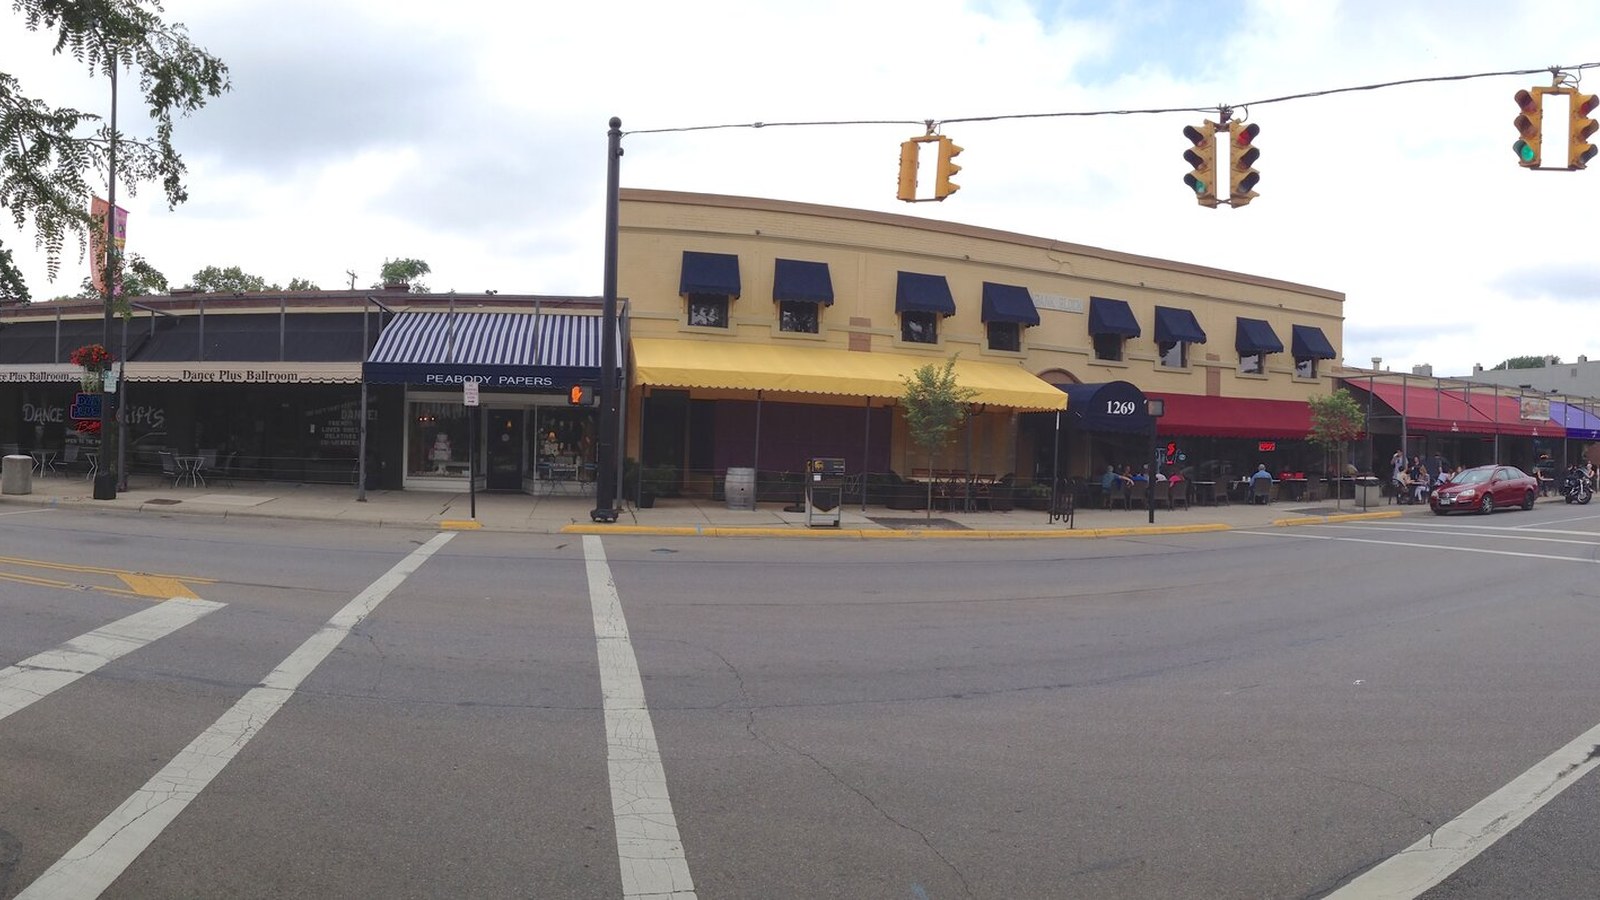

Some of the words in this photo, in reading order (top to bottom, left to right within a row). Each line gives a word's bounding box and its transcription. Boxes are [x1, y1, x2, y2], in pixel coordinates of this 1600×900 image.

[30, 371, 69, 380] Ballroom
[182, 370, 215, 380] Dance
[220, 370, 242, 380] Plus
[246, 370, 298, 380] Ballroom
[426, 374, 492, 384] PEABODY
[498, 376, 553, 386] PAPERS
[1106, 400, 1136, 415] 1269
[23, 403, 64, 425] DANCE
